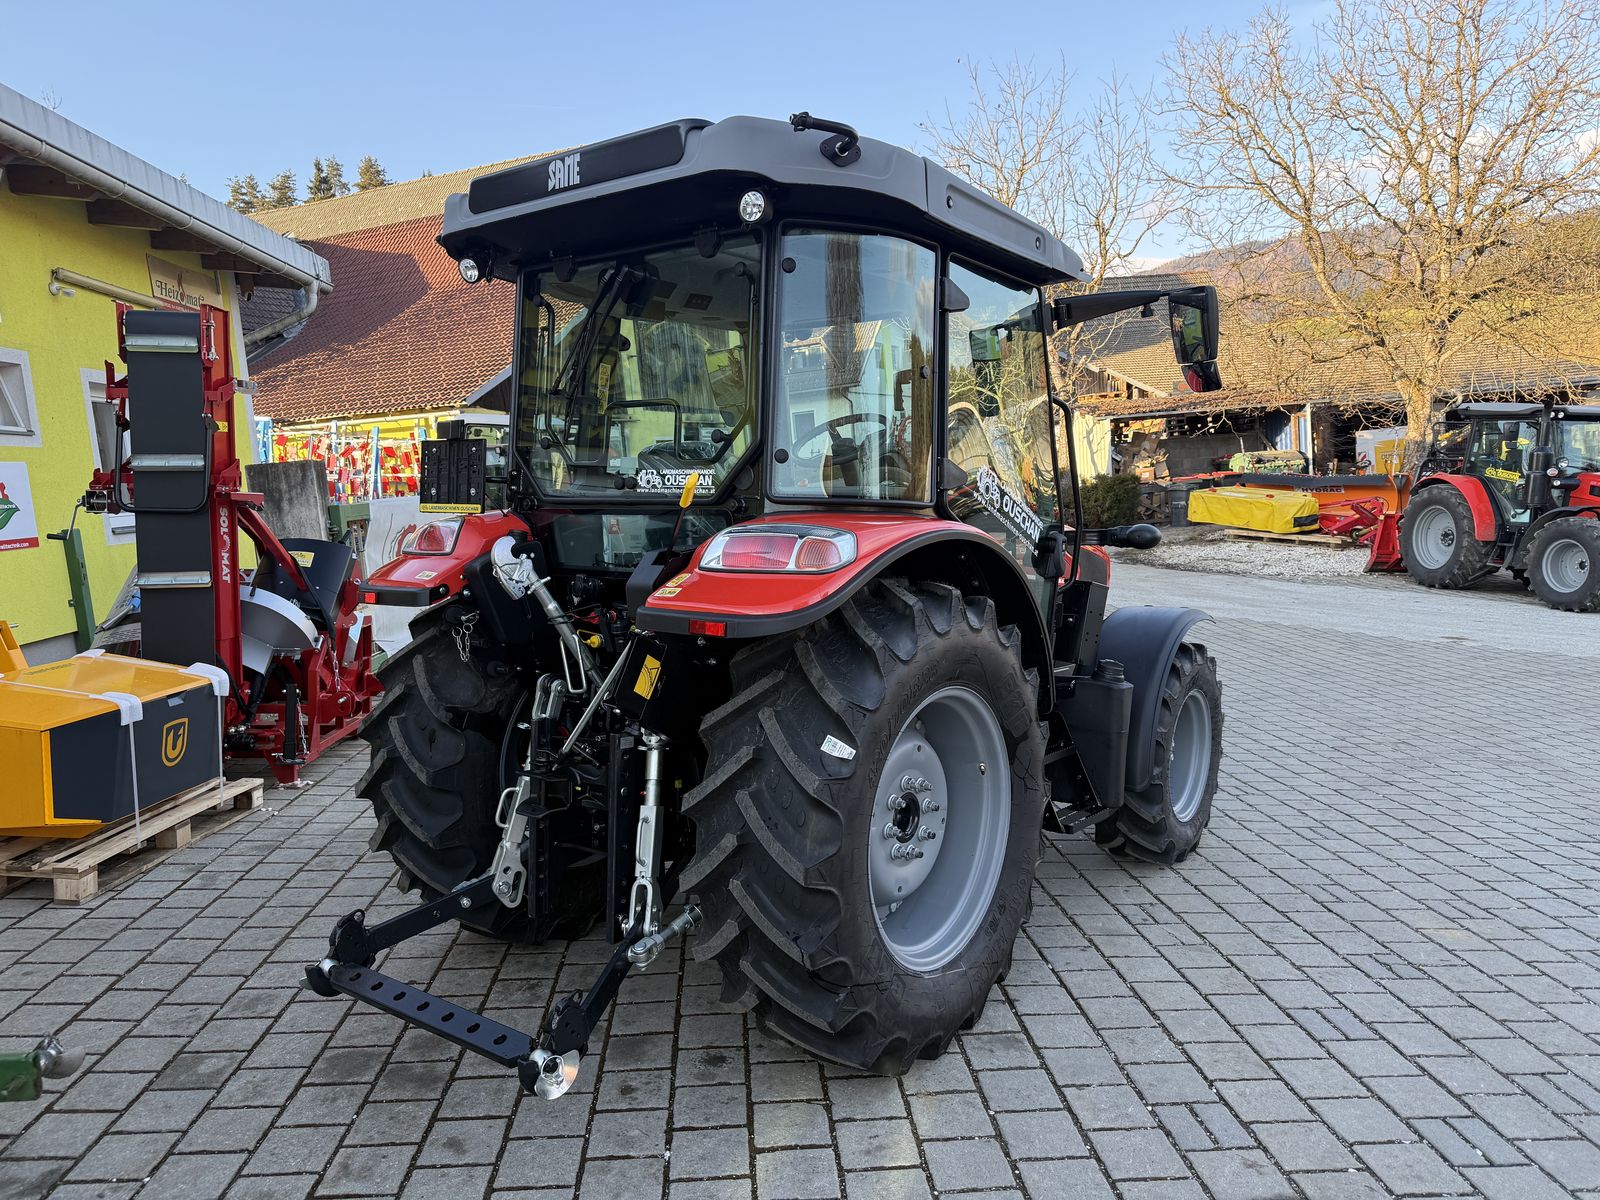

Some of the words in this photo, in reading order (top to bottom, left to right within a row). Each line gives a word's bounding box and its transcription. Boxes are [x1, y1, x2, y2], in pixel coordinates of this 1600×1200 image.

[548, 152, 580, 191] SAME
[665, 475, 712, 486] OUSAN
[1003, 495, 1040, 543] OUSCHAN
